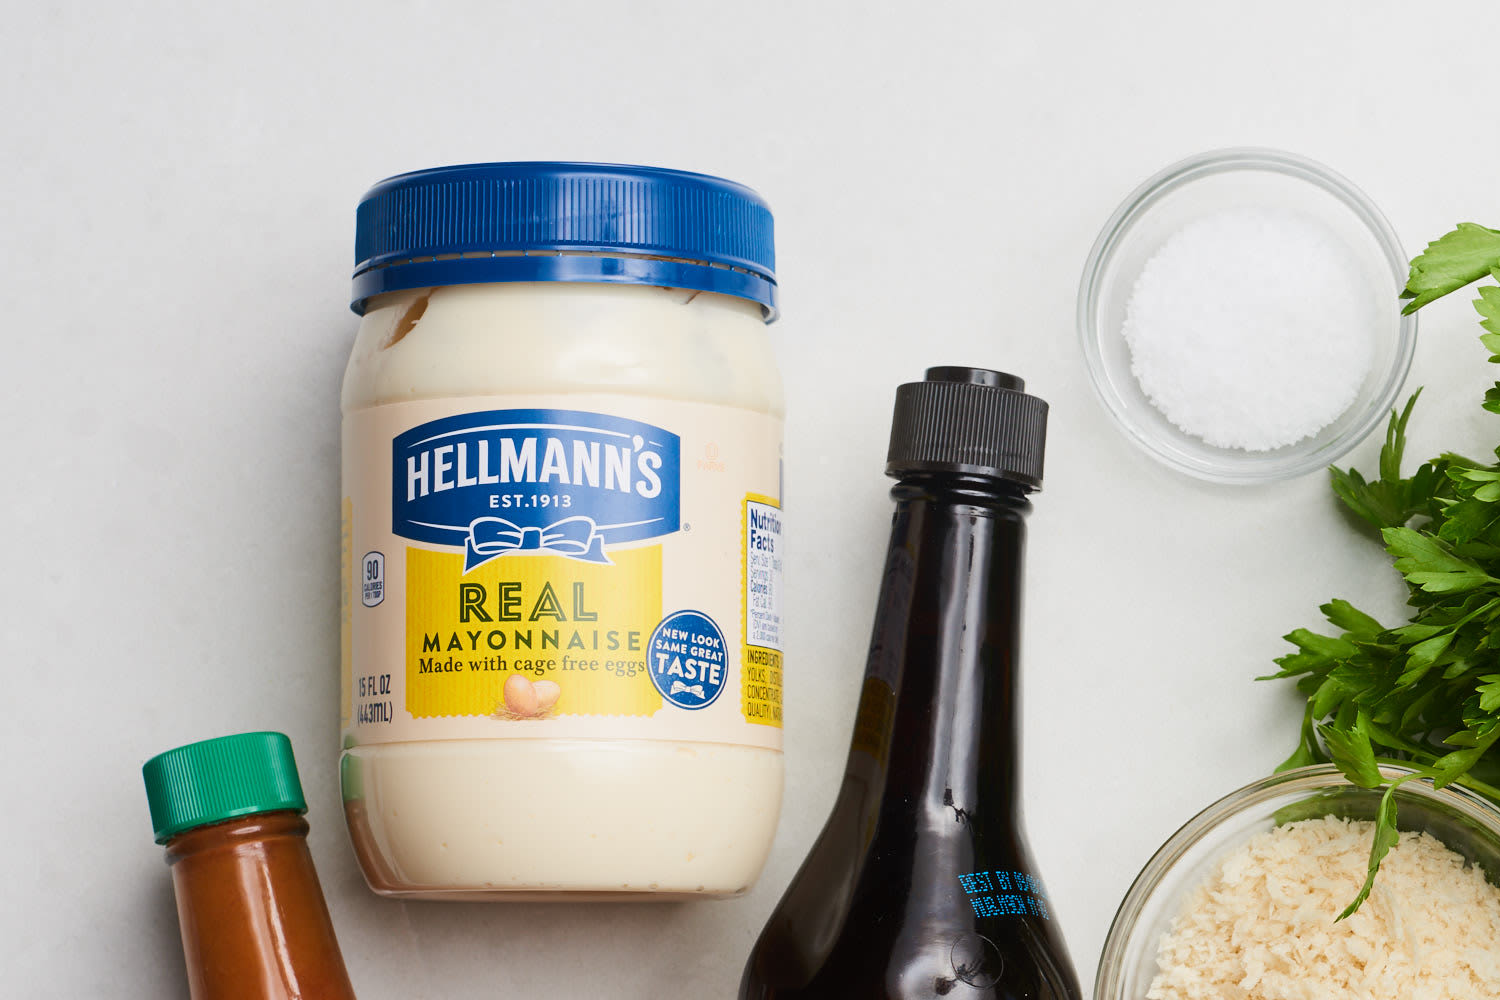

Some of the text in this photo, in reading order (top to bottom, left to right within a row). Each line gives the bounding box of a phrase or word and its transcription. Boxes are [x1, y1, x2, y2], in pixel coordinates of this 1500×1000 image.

[407, 435, 663, 502] HELLMANN'S
[751, 530, 774, 553] Facts
[367, 559, 379, 581] 90
[459, 582, 599, 623] REAL
[422, 630, 642, 653] MAYONNAISE
[662, 627, 720, 648] NEW LOOK
[655, 639, 723, 662] SAME GREAT
[419, 656, 645, 678] Made with cage free eggs
[655, 652, 721, 685] TASTE
[358, 674, 391, 698] 15 FL OZ
[958, 871, 994, 894] BEST
